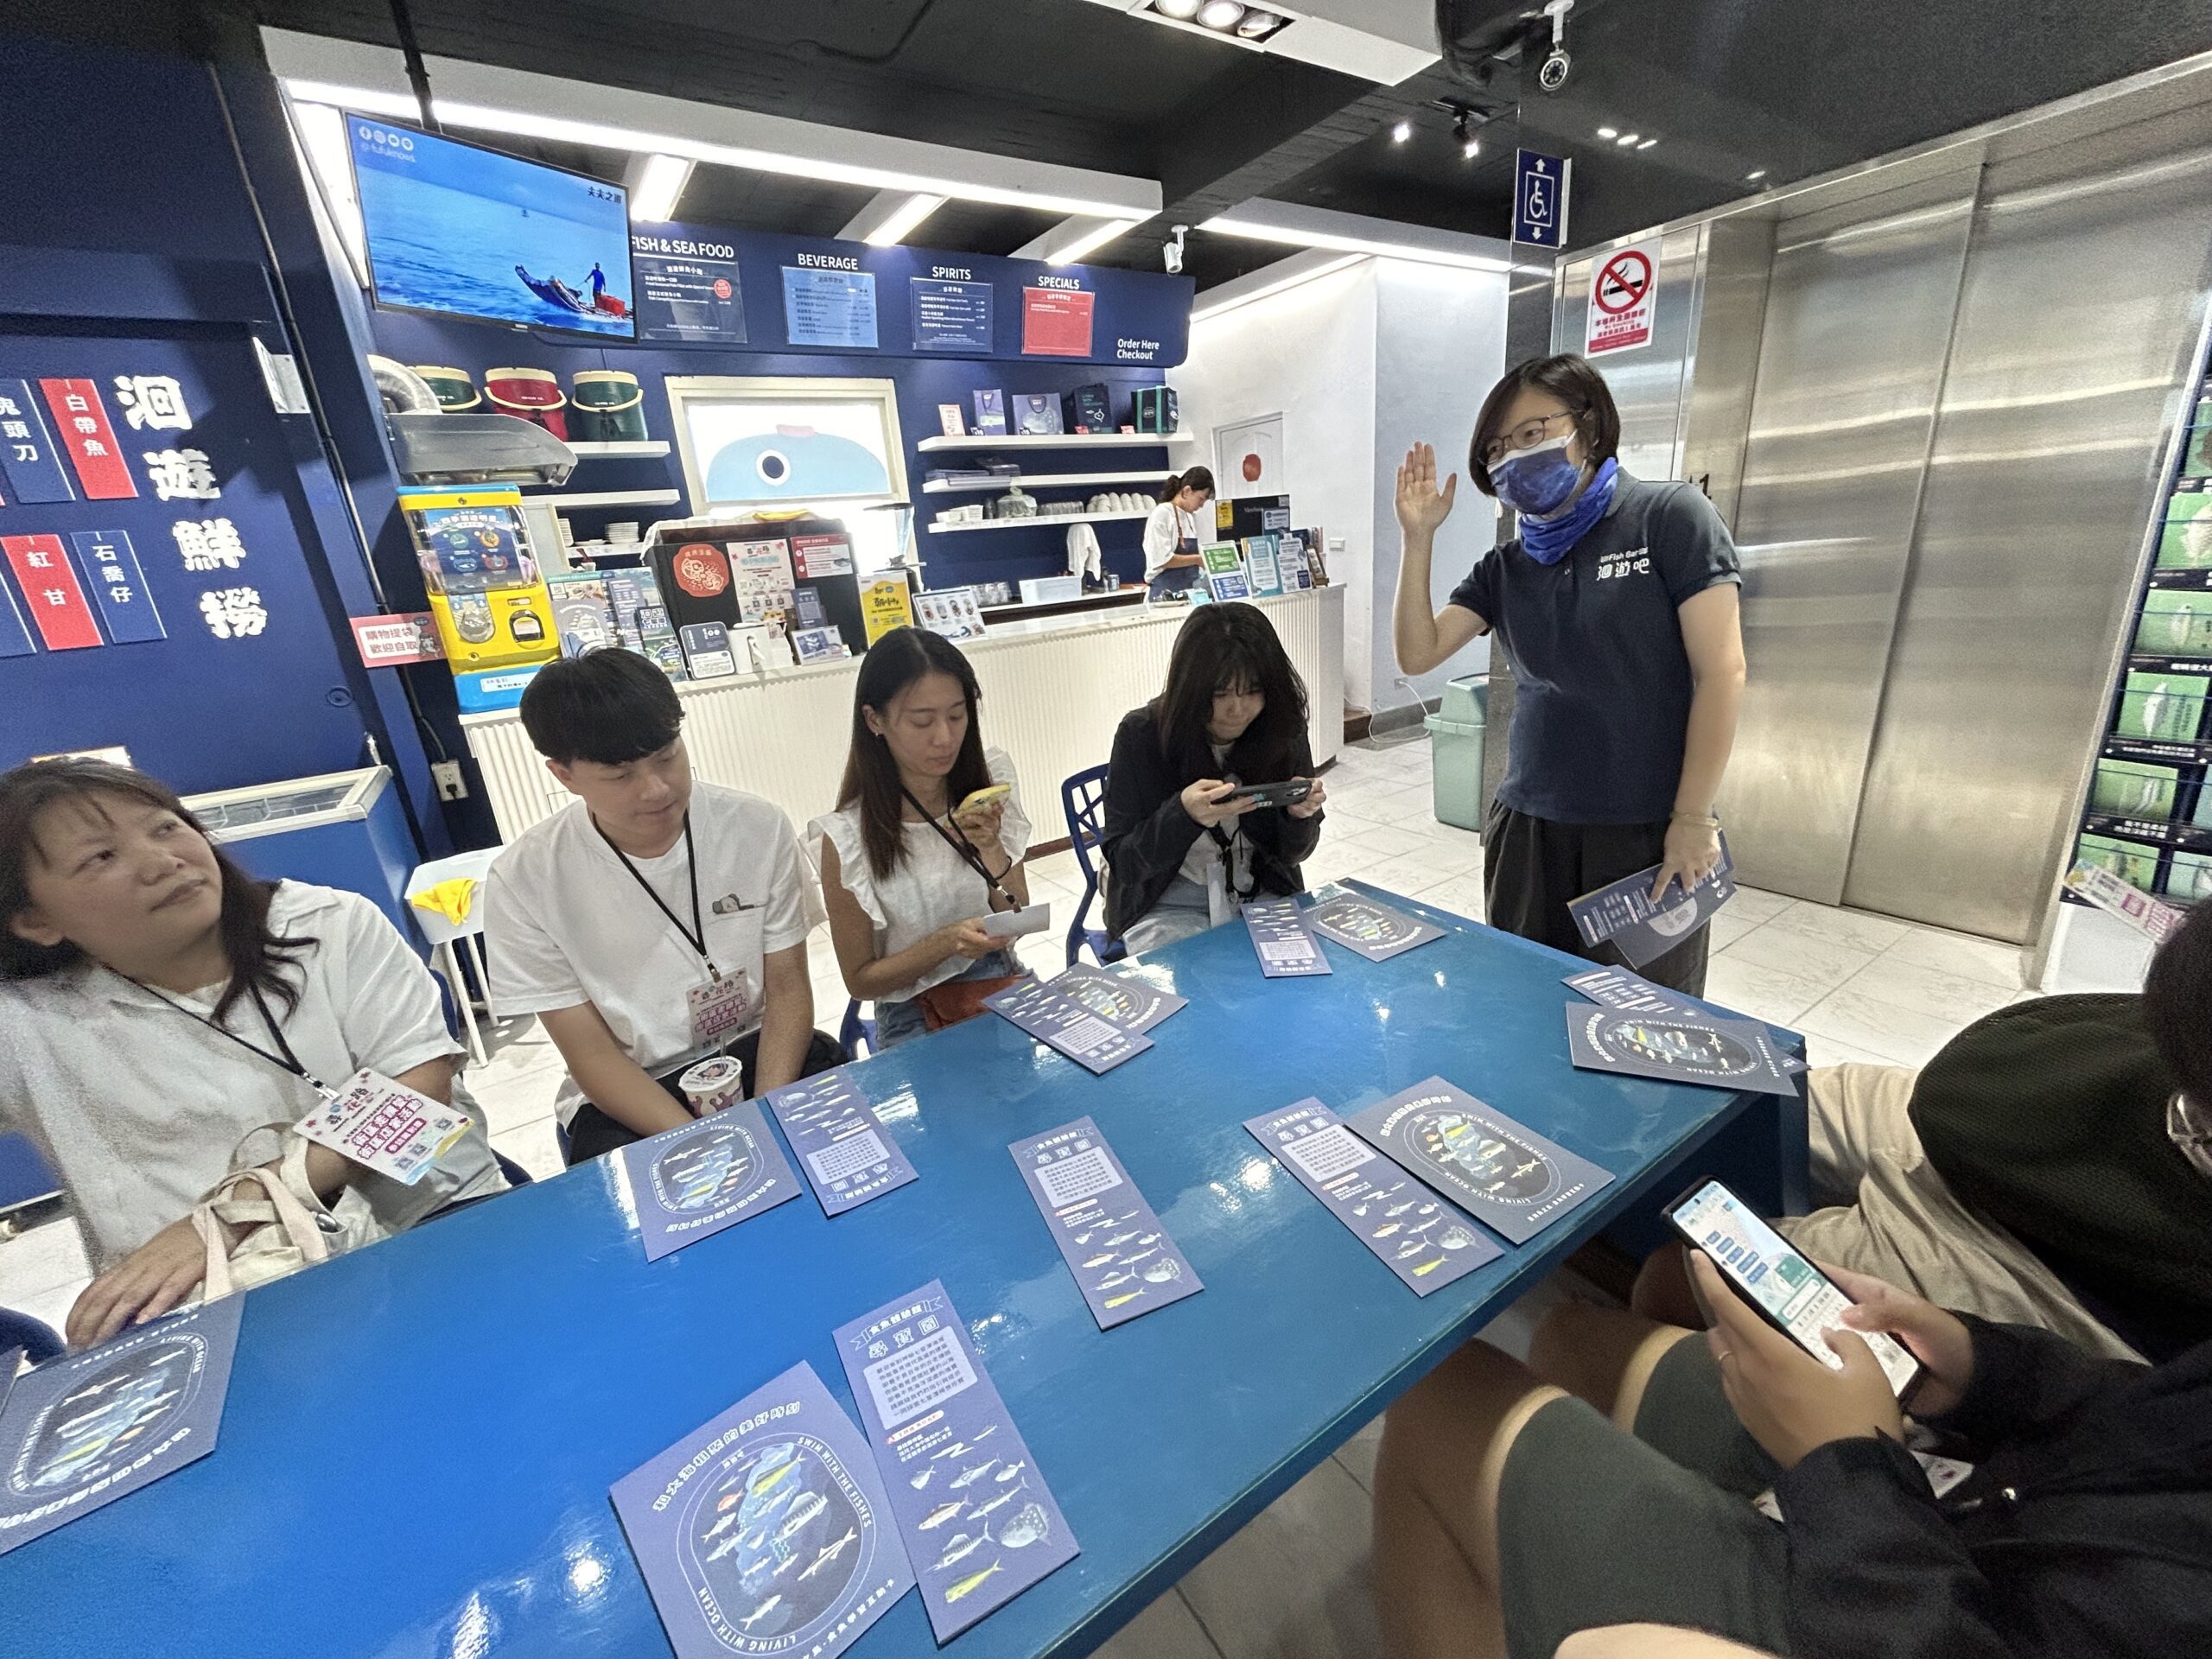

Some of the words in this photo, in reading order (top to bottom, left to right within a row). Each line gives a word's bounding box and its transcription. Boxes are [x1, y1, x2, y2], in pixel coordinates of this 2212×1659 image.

[660, 238, 671, 252] &
[672, 240, 698, 255] SEA
[698, 243, 734, 258] FOOD
[798, 253, 858, 270] BEVERAGE
[932, 266, 971, 280] SPIRITS
[1038, 276, 1080, 290] SPECIALS
[1117, 338, 1140, 349] Order
[1141, 340, 1160, 350] Here
[1117, 348, 1154, 360] Checkout
[65, 393, 109, 457] 白帶魚
[27, 551, 66, 606] 紅甘
[652, 1401, 800, 1511] 和大海相聚的美好時刻
[798, 1436, 823, 1452] SWIM
[822, 1450, 841, 1474] WITH
[837, 1472, 853, 1491] THE
[849, 1491, 872, 1529] FISHES
[698, 1586, 721, 1624] OCEAN
[716, 1625, 745, 1648] WITH
[748, 1635, 796, 1651] LIVING
